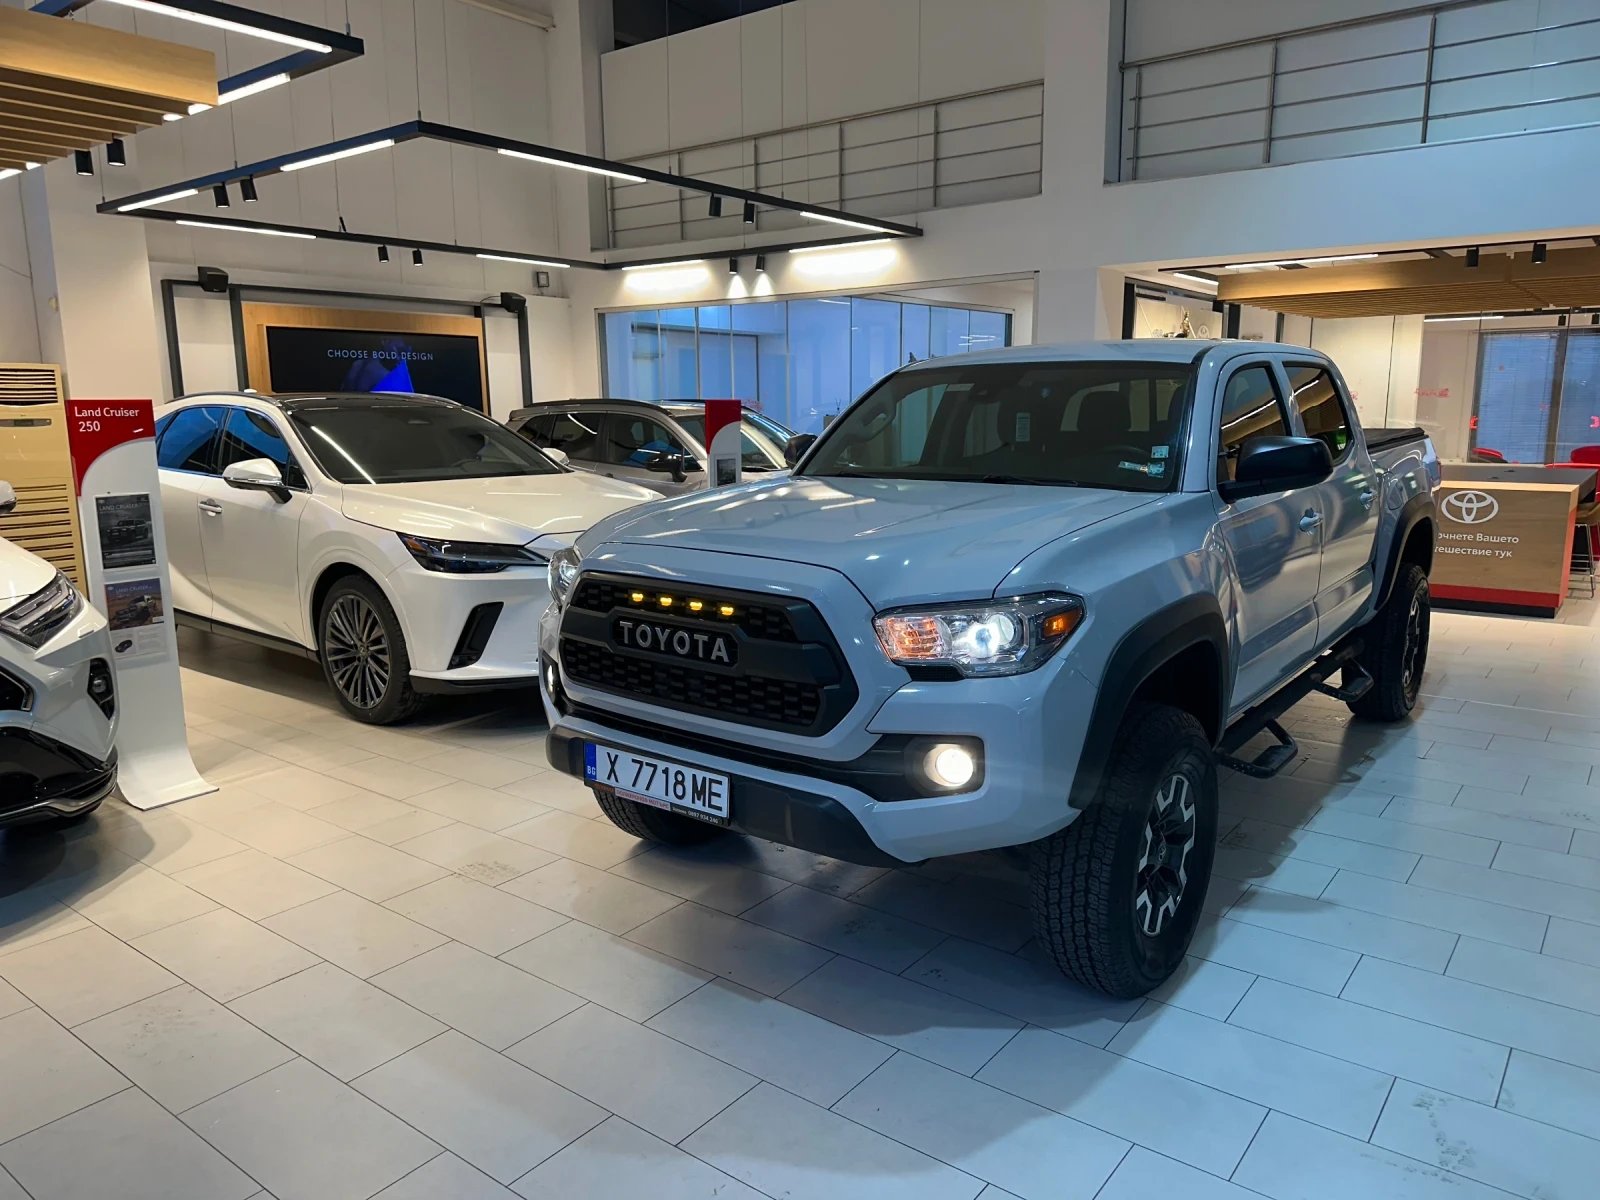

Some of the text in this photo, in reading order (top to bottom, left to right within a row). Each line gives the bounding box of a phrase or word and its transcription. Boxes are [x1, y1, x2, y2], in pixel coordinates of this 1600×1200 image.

[327, 349, 434, 361] CHOOSE BOLD DESIGN
[74, 406, 140, 417] Land Cruiser
[78, 420, 101, 432] 250
[1438, 532, 1519, 544] очнете Вашето
[1434, 546, 1513, 559] тешествие тук
[619, 620, 730, 663] TOYOTA
[587, 765, 596, 776] BG
[631, 758, 686, 800] 7718
